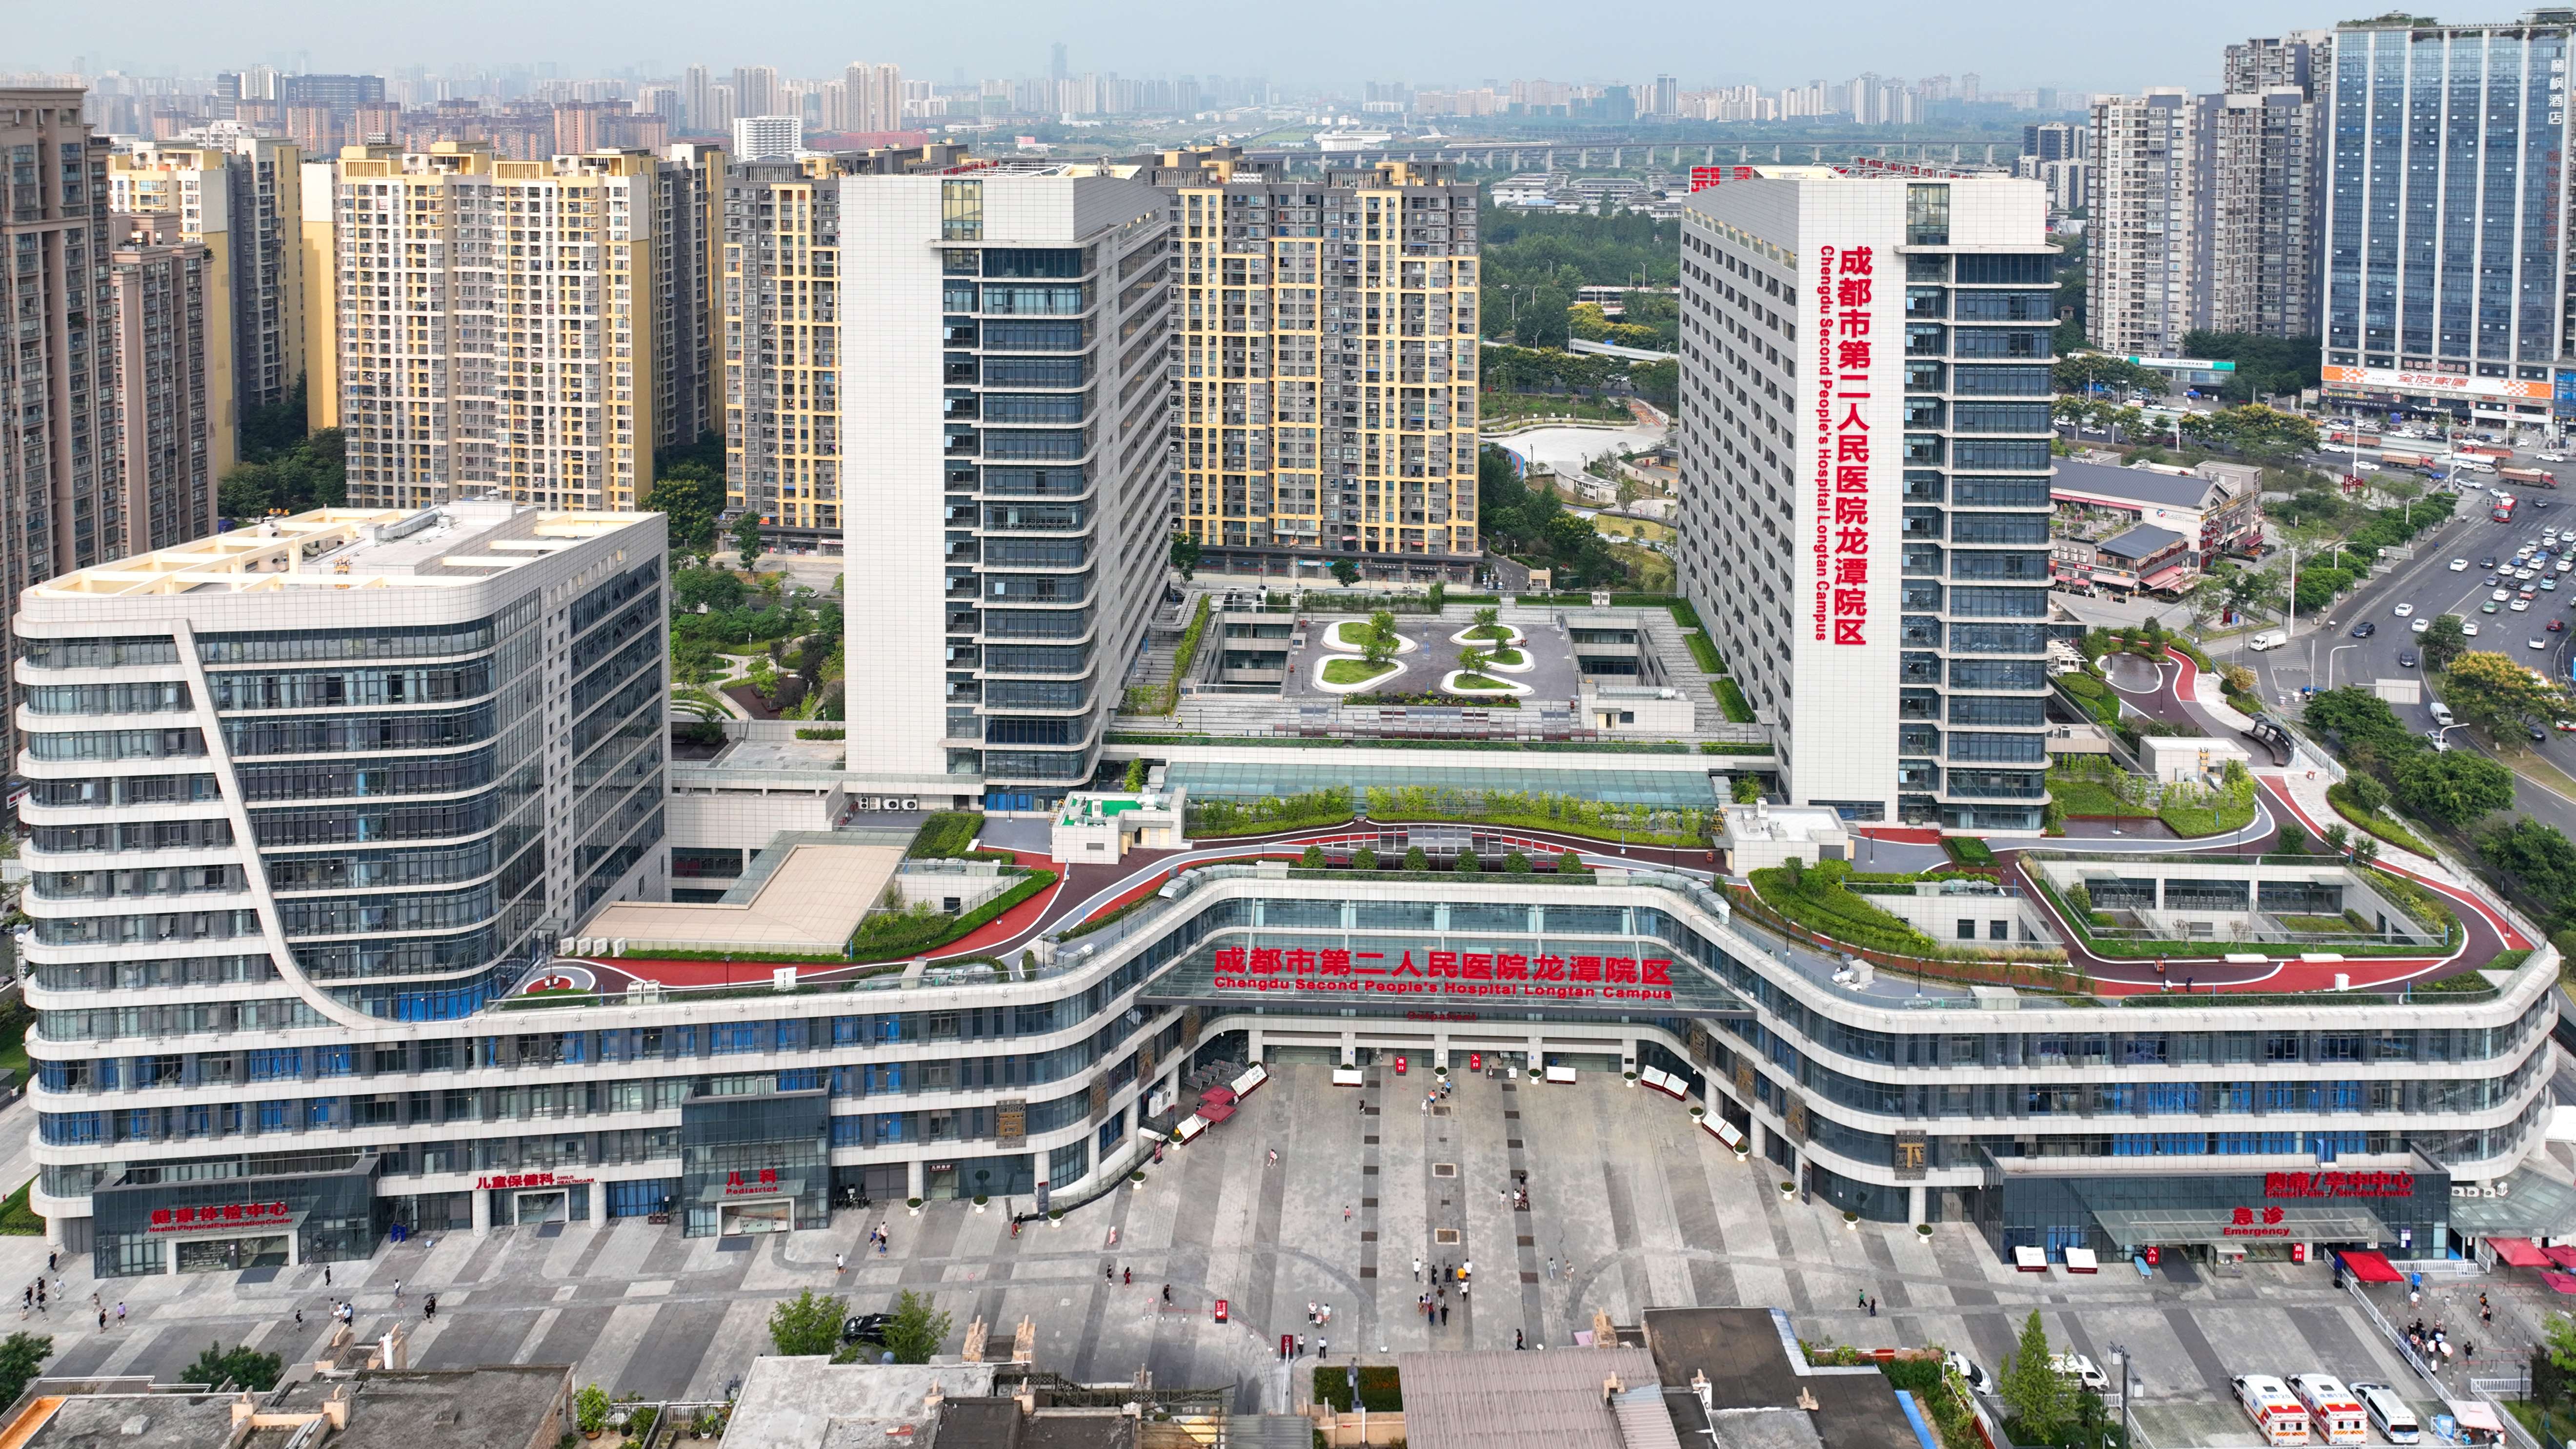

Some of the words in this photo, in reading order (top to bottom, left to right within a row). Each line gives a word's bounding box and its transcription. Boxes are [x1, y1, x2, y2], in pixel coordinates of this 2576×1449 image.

[2548, 60, 2564, 125] 麗枫酒店
[1817, 245, 1834, 314] Chengdu
[1819, 319, 1833, 376] Second
[2397, 373, 2469, 387] 全友家居
[1816, 380, 1832, 444] People's
[1834, 245, 1873, 645] 成都市第二人民医院龙潭院区
[1814, 449, 1831, 511] Hospital
[1813, 515, 1831, 577] Longtan
[1812, 581, 1830, 641] Campus
[1214, 946, 1673, 986] 成都市第二人民医院龙潭院区
[1214, 977, 1289, 991] Chengdu
[1295, 979, 1358, 991] Second
[1365, 980, 1438, 994] People's
[1445, 982, 1517, 996] Hospital
[1524, 984, 1594, 999] Longtan
[1603, 986, 1672, 1001] Campus
[476, 1173, 554, 1189] 儿童保健科
[725, 1186, 778, 1194] Pediatrics
[726, 1168, 778, 1186] 儿科
[149, 1225, 176, 1233] Health
[151, 1202, 288, 1225] 健康体检中心
[2232, 1206, 2285, 1226] 急诊
[2223, 1228, 2290, 1237] Emergency
